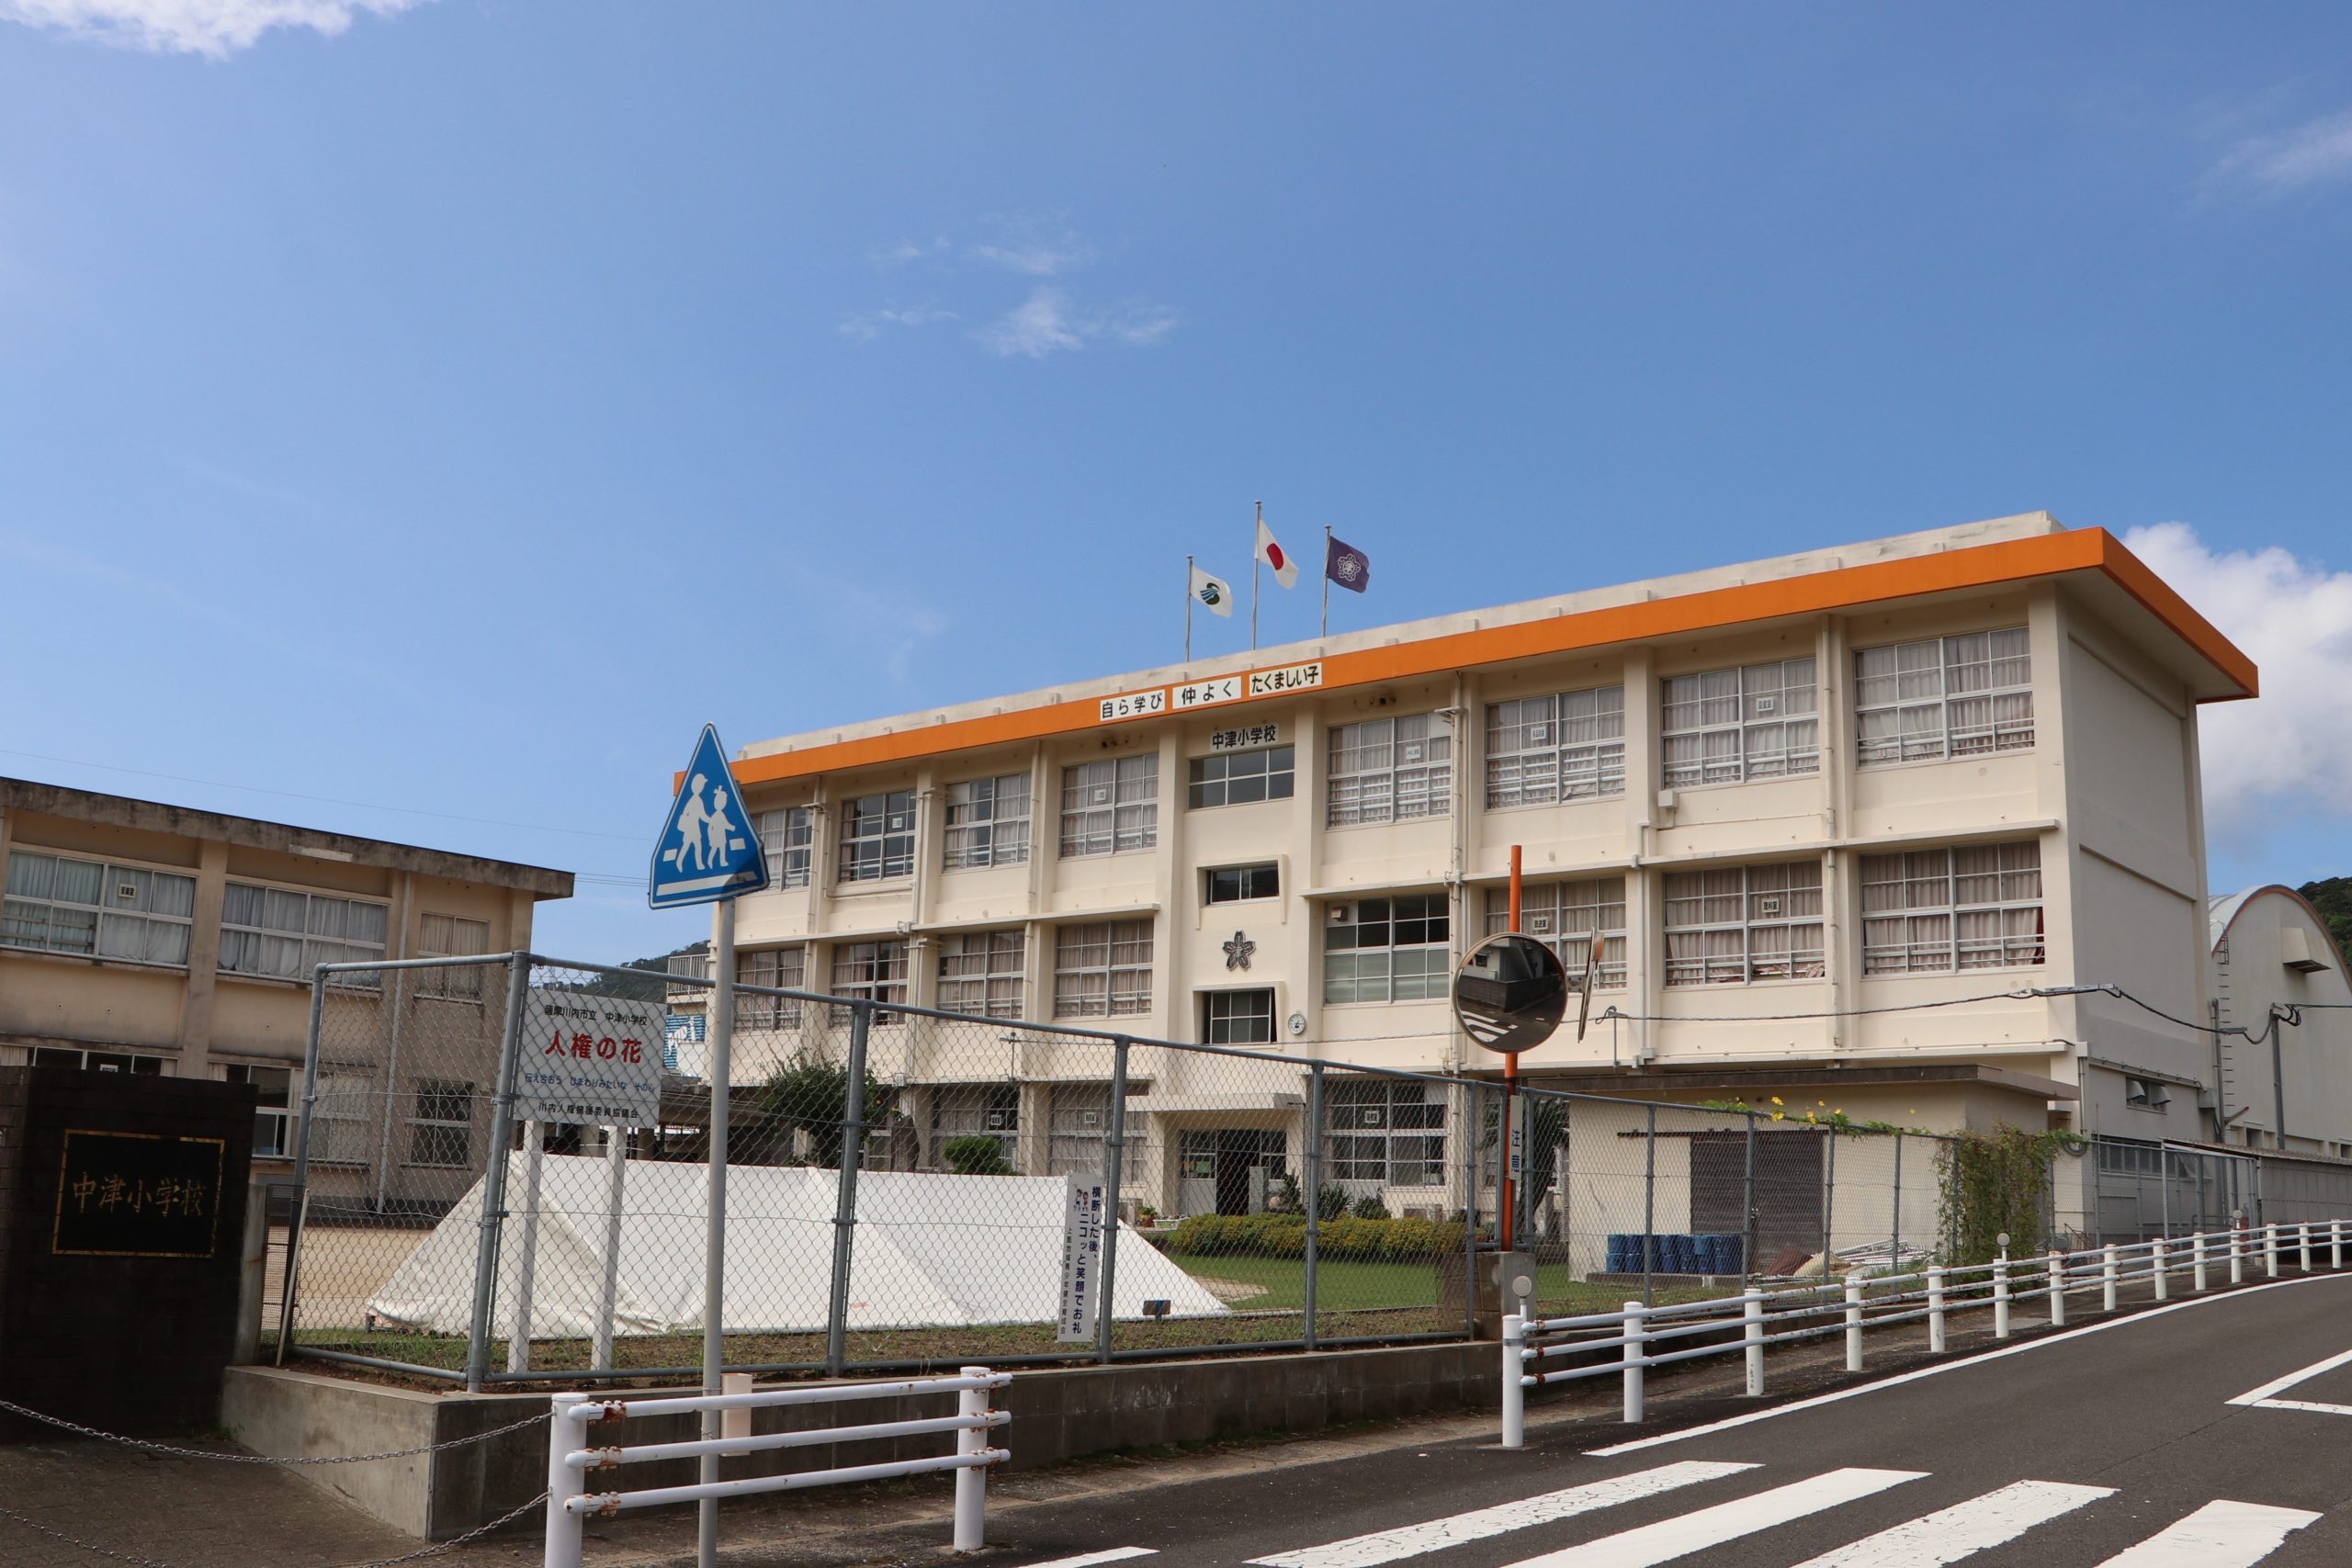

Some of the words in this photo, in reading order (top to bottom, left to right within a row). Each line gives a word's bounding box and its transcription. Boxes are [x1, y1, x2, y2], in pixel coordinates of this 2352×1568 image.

[1102, 692, 1163, 719] 自ら学び
[1182, 680, 1233, 705] 仲よく
[1251, 665, 1319, 694] たくましい子
[1211, 724, 1277, 750] 中津小学校
[544, 1004, 597, 1021] 薩摩川内市立
[605, 1011, 648, 1026] 中津小学校
[545, 1030, 643, 1065] 人権の花
[73, 1171, 207, 1218] 中津小学校
[1089, 1186, 1102, 1258] 横断した後、
[1072, 1213, 1090, 1335] ニコッと笑顔でお礼
